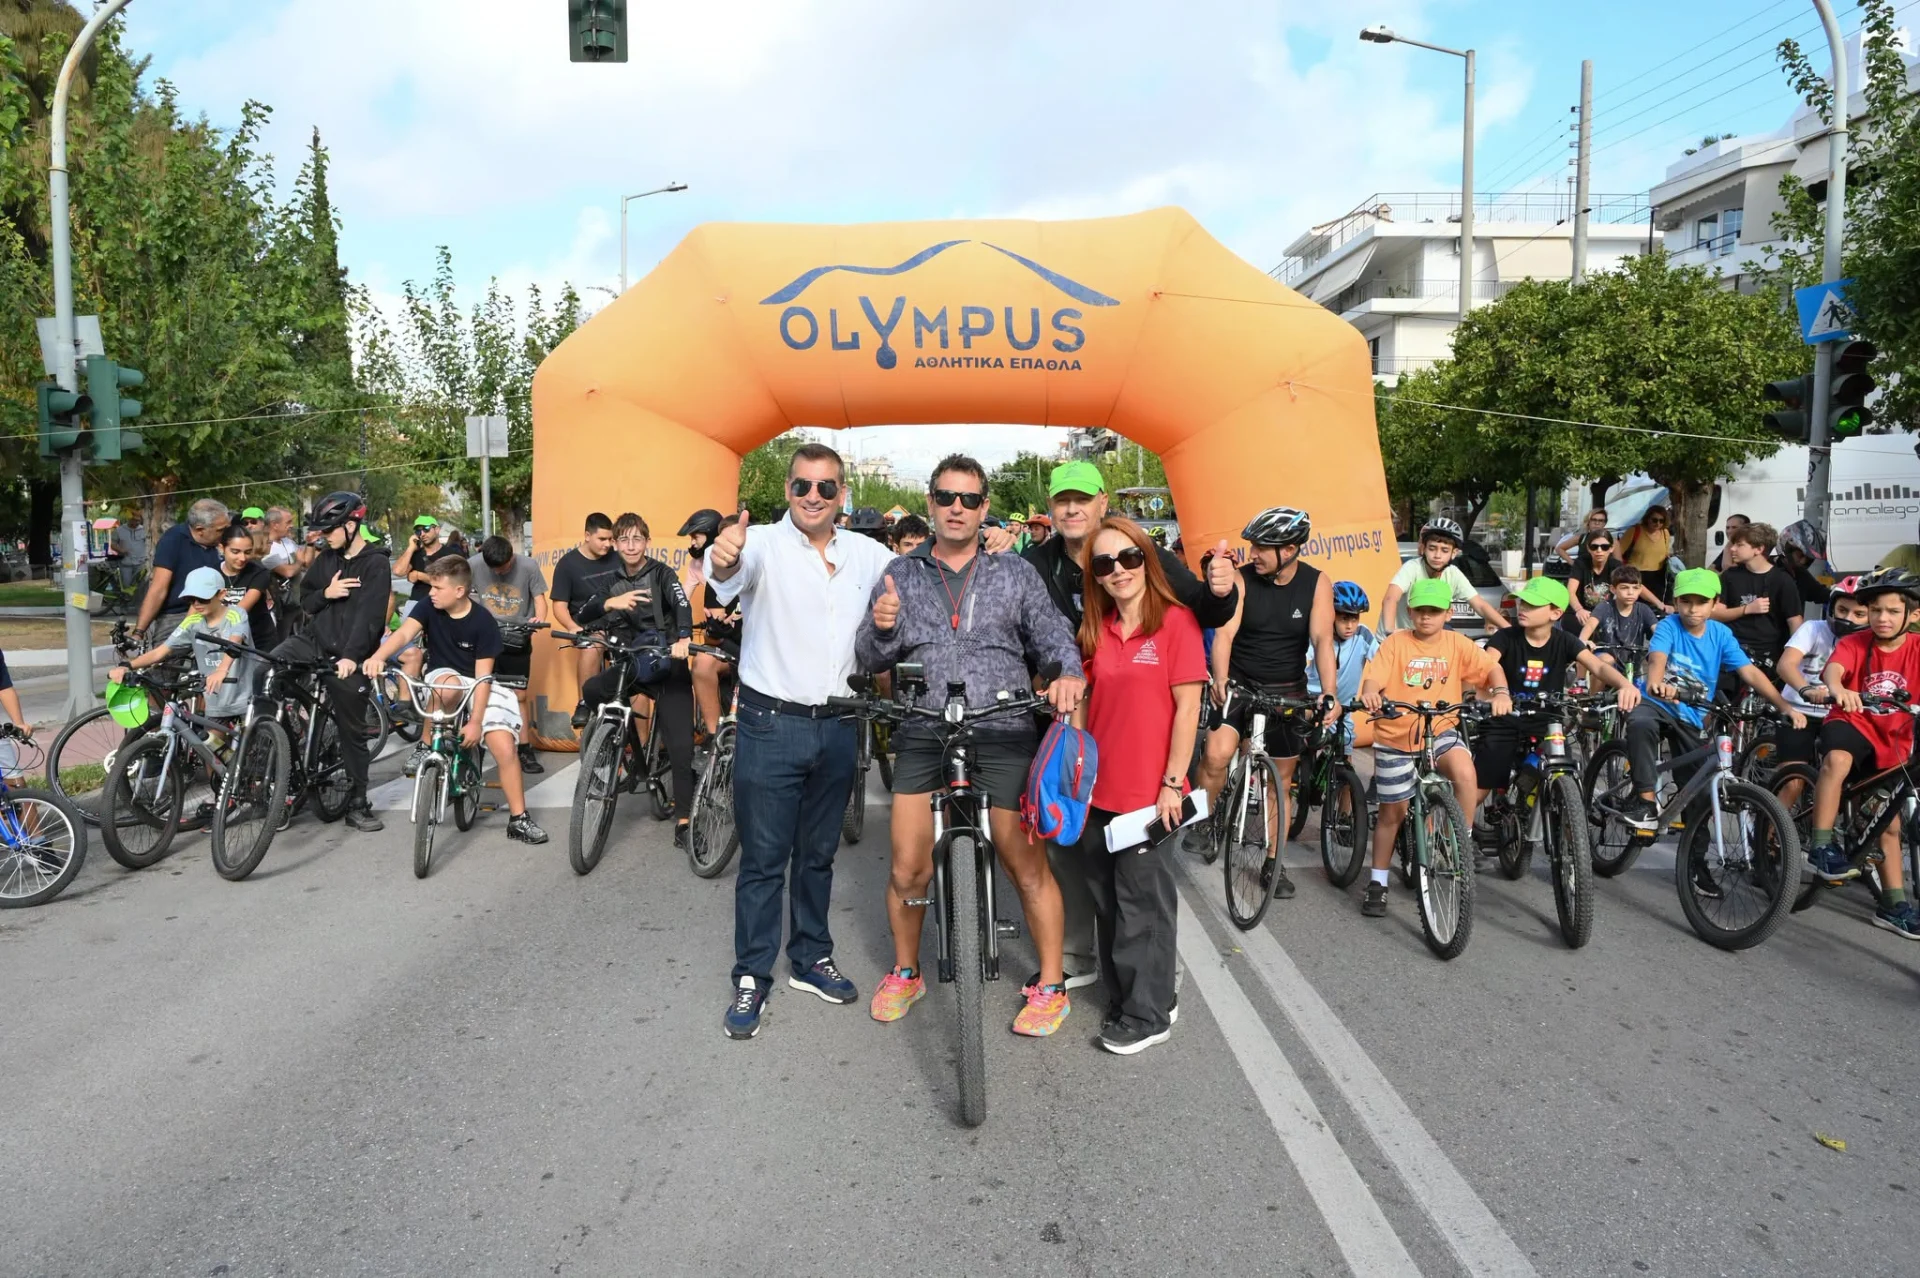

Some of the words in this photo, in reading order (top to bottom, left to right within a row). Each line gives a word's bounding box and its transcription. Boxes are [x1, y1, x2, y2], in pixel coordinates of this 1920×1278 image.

[779, 295, 1086, 370] OLYMPUS
[914, 356, 1005, 369] ΑΘΛΗΤΙΚΑ
[1010, 357, 1082, 371] ΕΠΑΘΛΑ
